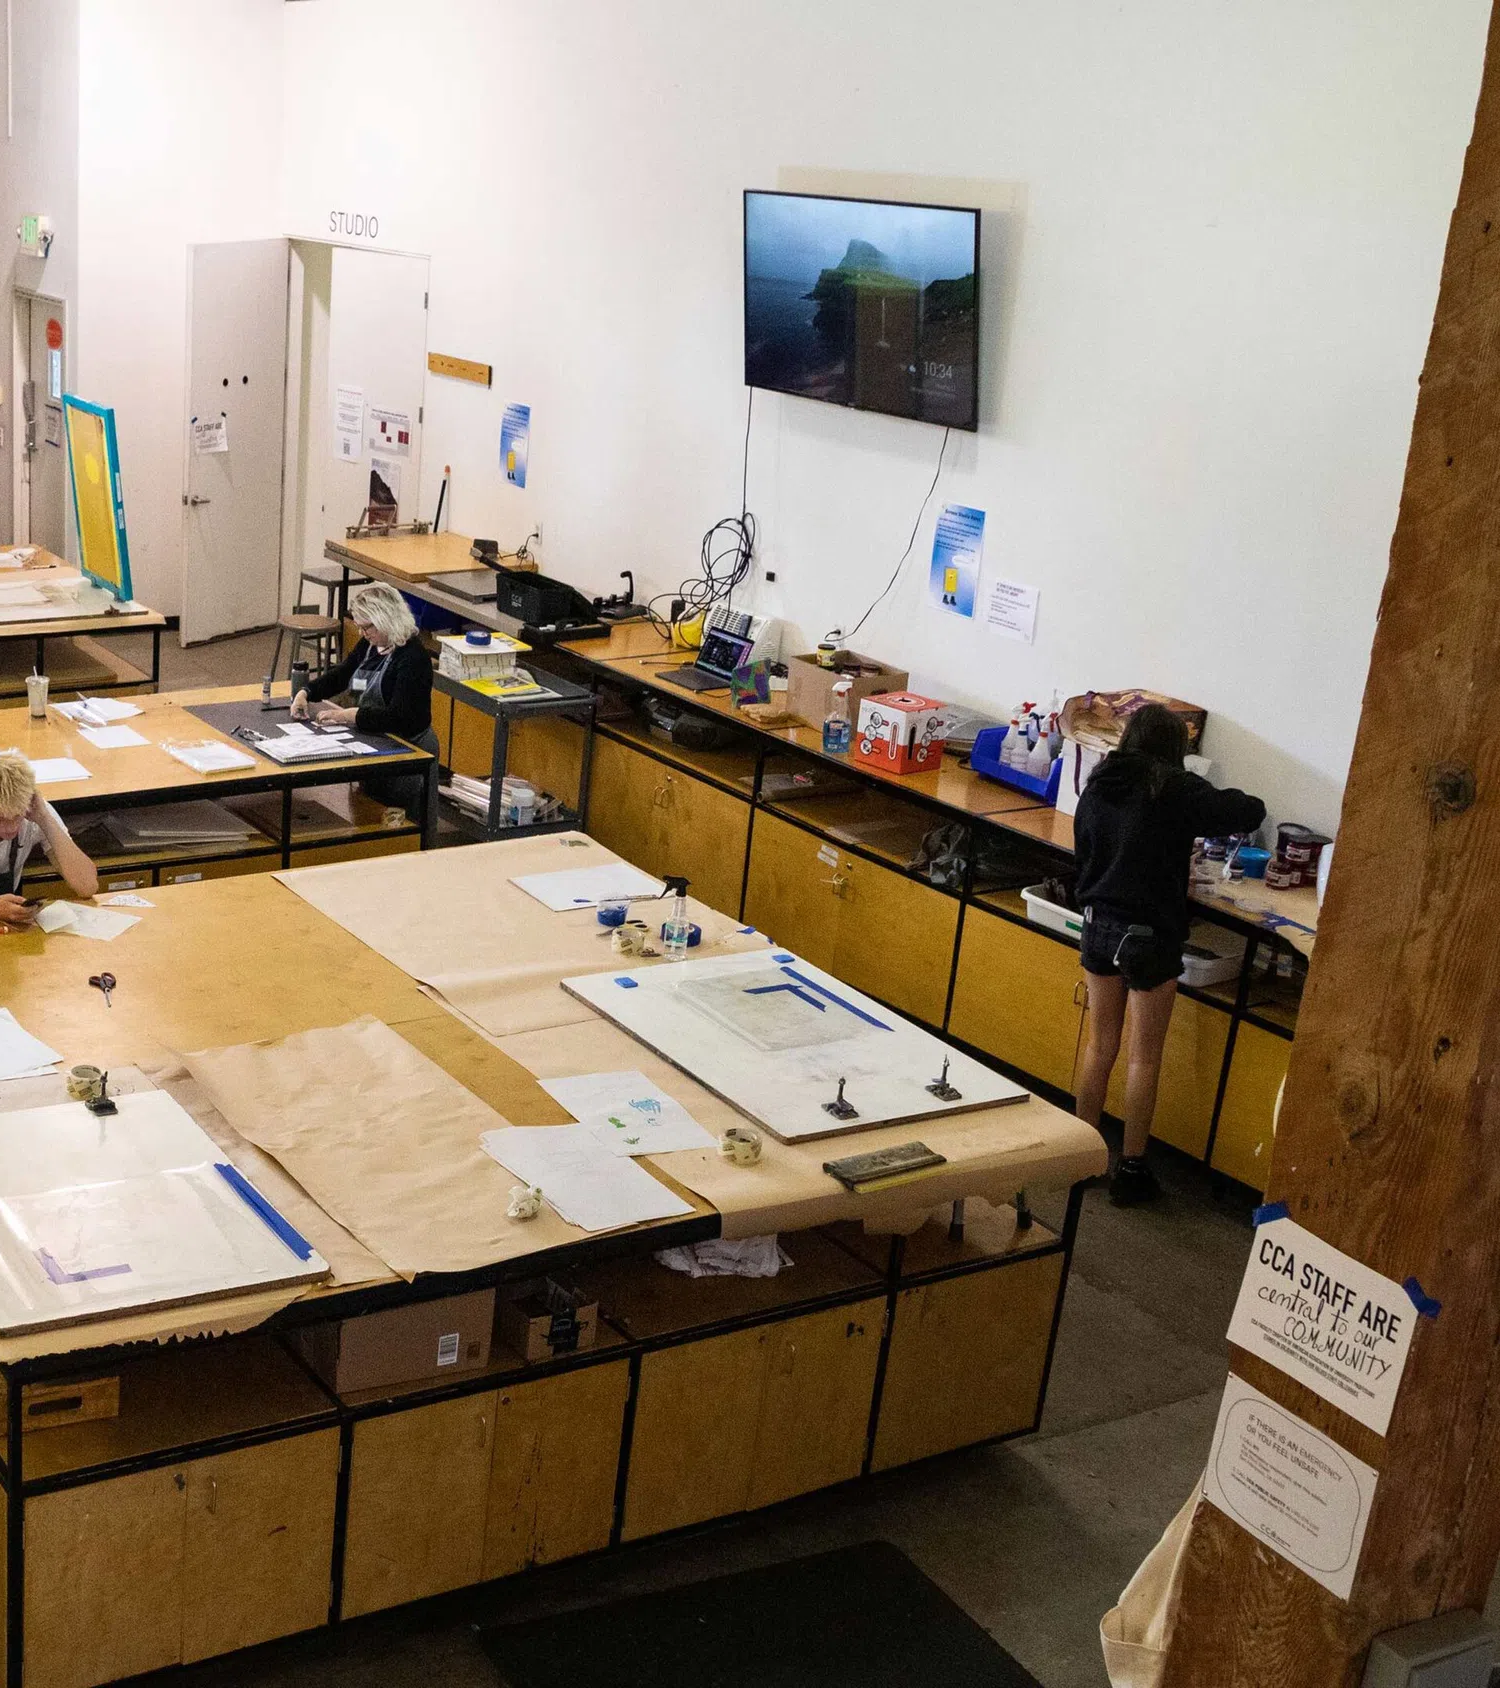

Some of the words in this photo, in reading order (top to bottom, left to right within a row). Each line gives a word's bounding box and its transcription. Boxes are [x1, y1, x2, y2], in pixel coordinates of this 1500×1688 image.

[329, 210, 379, 239] STUDIO
[923, 361, 953, 379] 10:34
[1257, 1286, 1325, 1324] central
[1330, 1308, 1350, 1335] to
[1353, 1329, 1382, 1351] our
[1259, 1238, 1295, 1281] CCA
[1300, 1262, 1357, 1314] STAFF
[1358, 1300, 1402, 1344] ARE
[1283, 1316, 1392, 1381] COMMUNITY
[1246, 1424, 1256, 1435] OR
[1257, 1432, 1272, 1447] YOU
[1272, 1442, 1289, 1459] FEEL
[1290, 1455, 1320, 1479] UNSAFE
[1256, 1418, 1278, 1438] THERE
[1278, 1435, 1287, 1444] IS
[1287, 1440, 1299, 1452] AN
